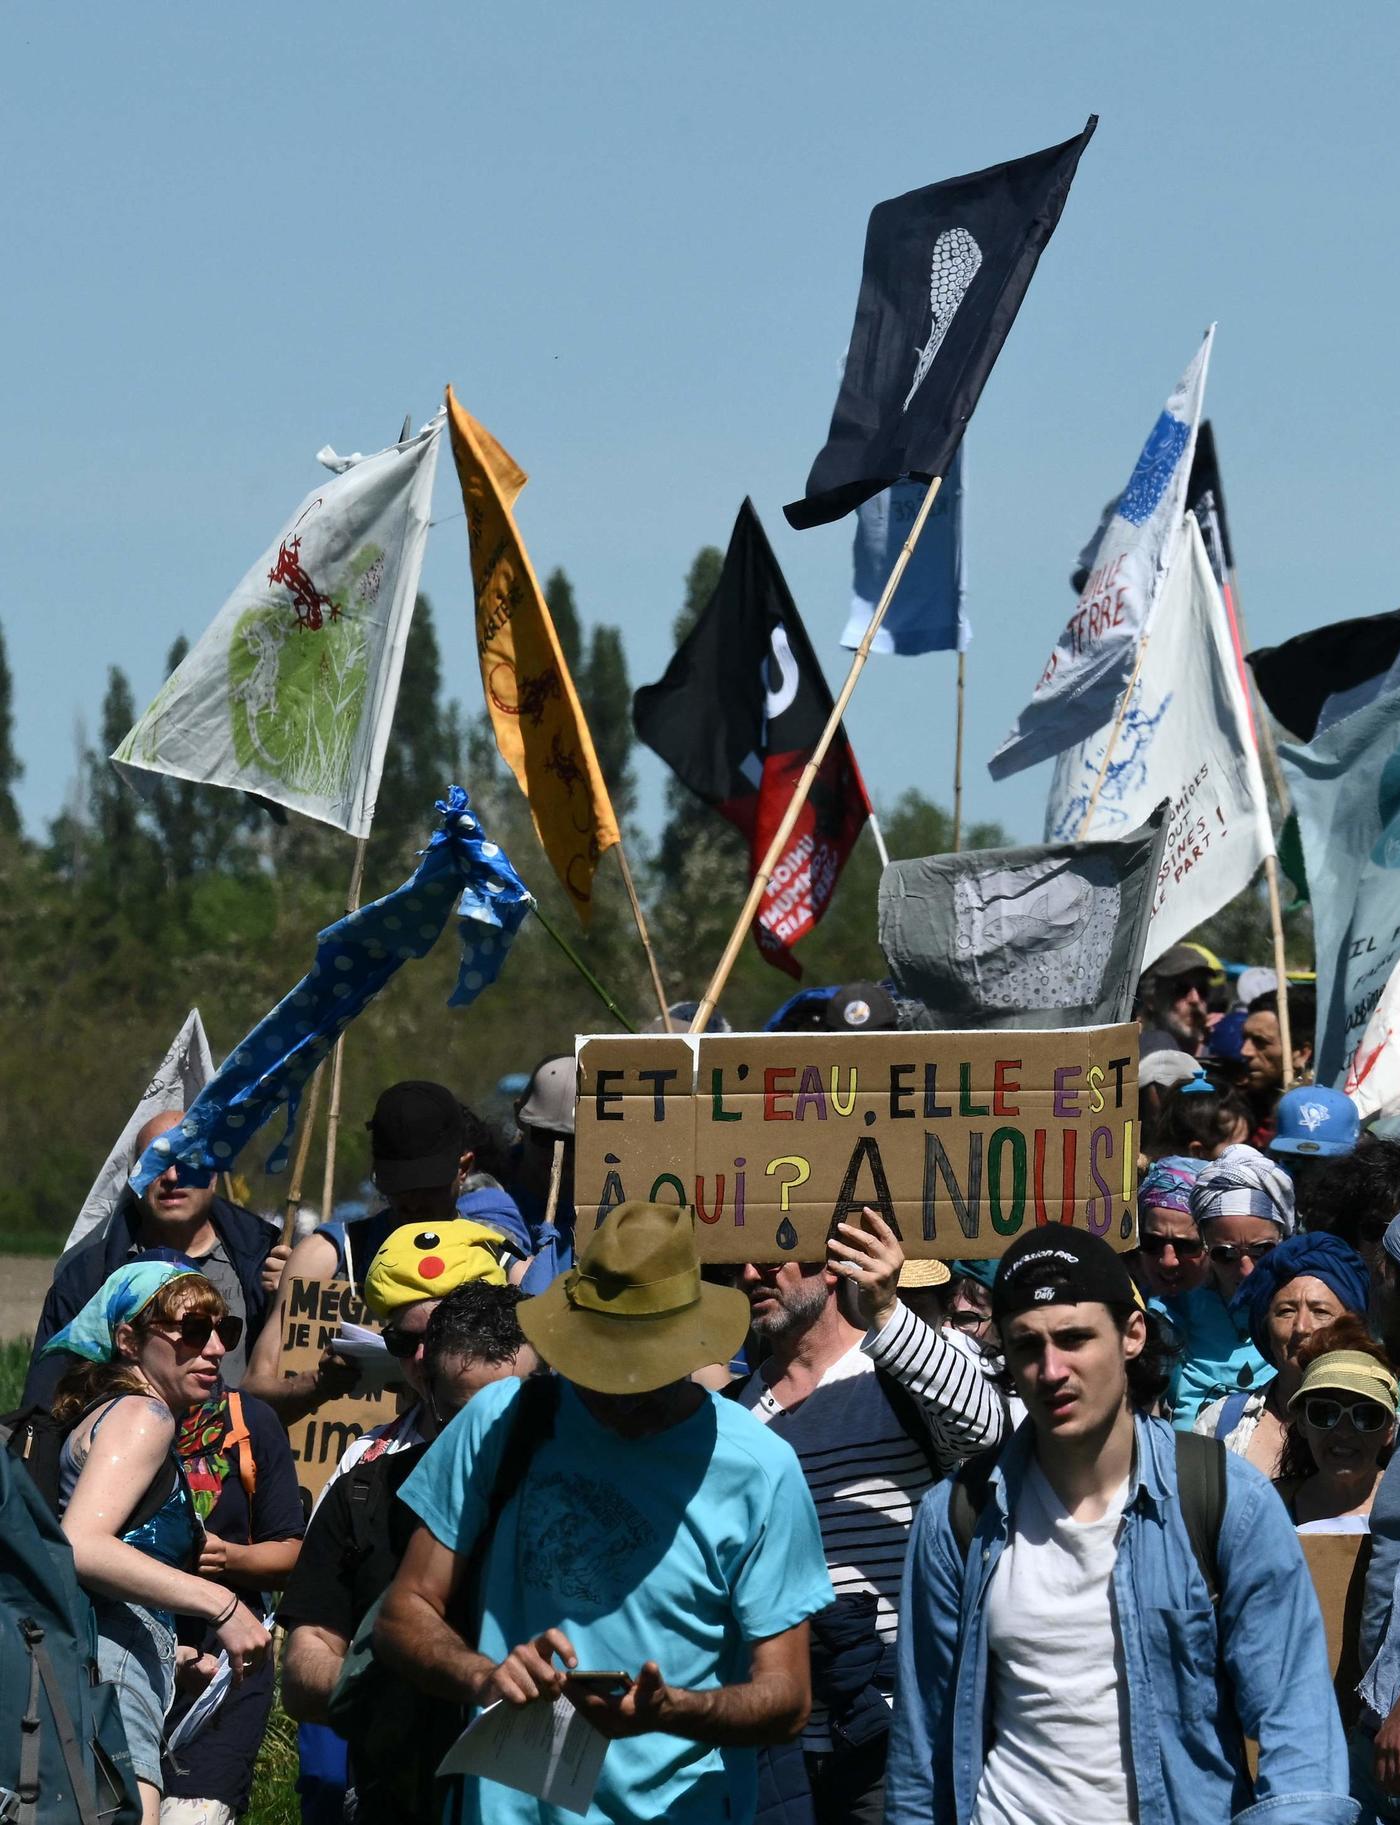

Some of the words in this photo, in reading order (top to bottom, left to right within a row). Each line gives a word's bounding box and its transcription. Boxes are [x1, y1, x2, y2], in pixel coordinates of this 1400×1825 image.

[596, 1069, 678, 1122] ET
[889, 1059, 1023, 1120] ELLE
[1053, 1057, 1132, 1119] EST
[283, 1322, 309, 1351] JE
